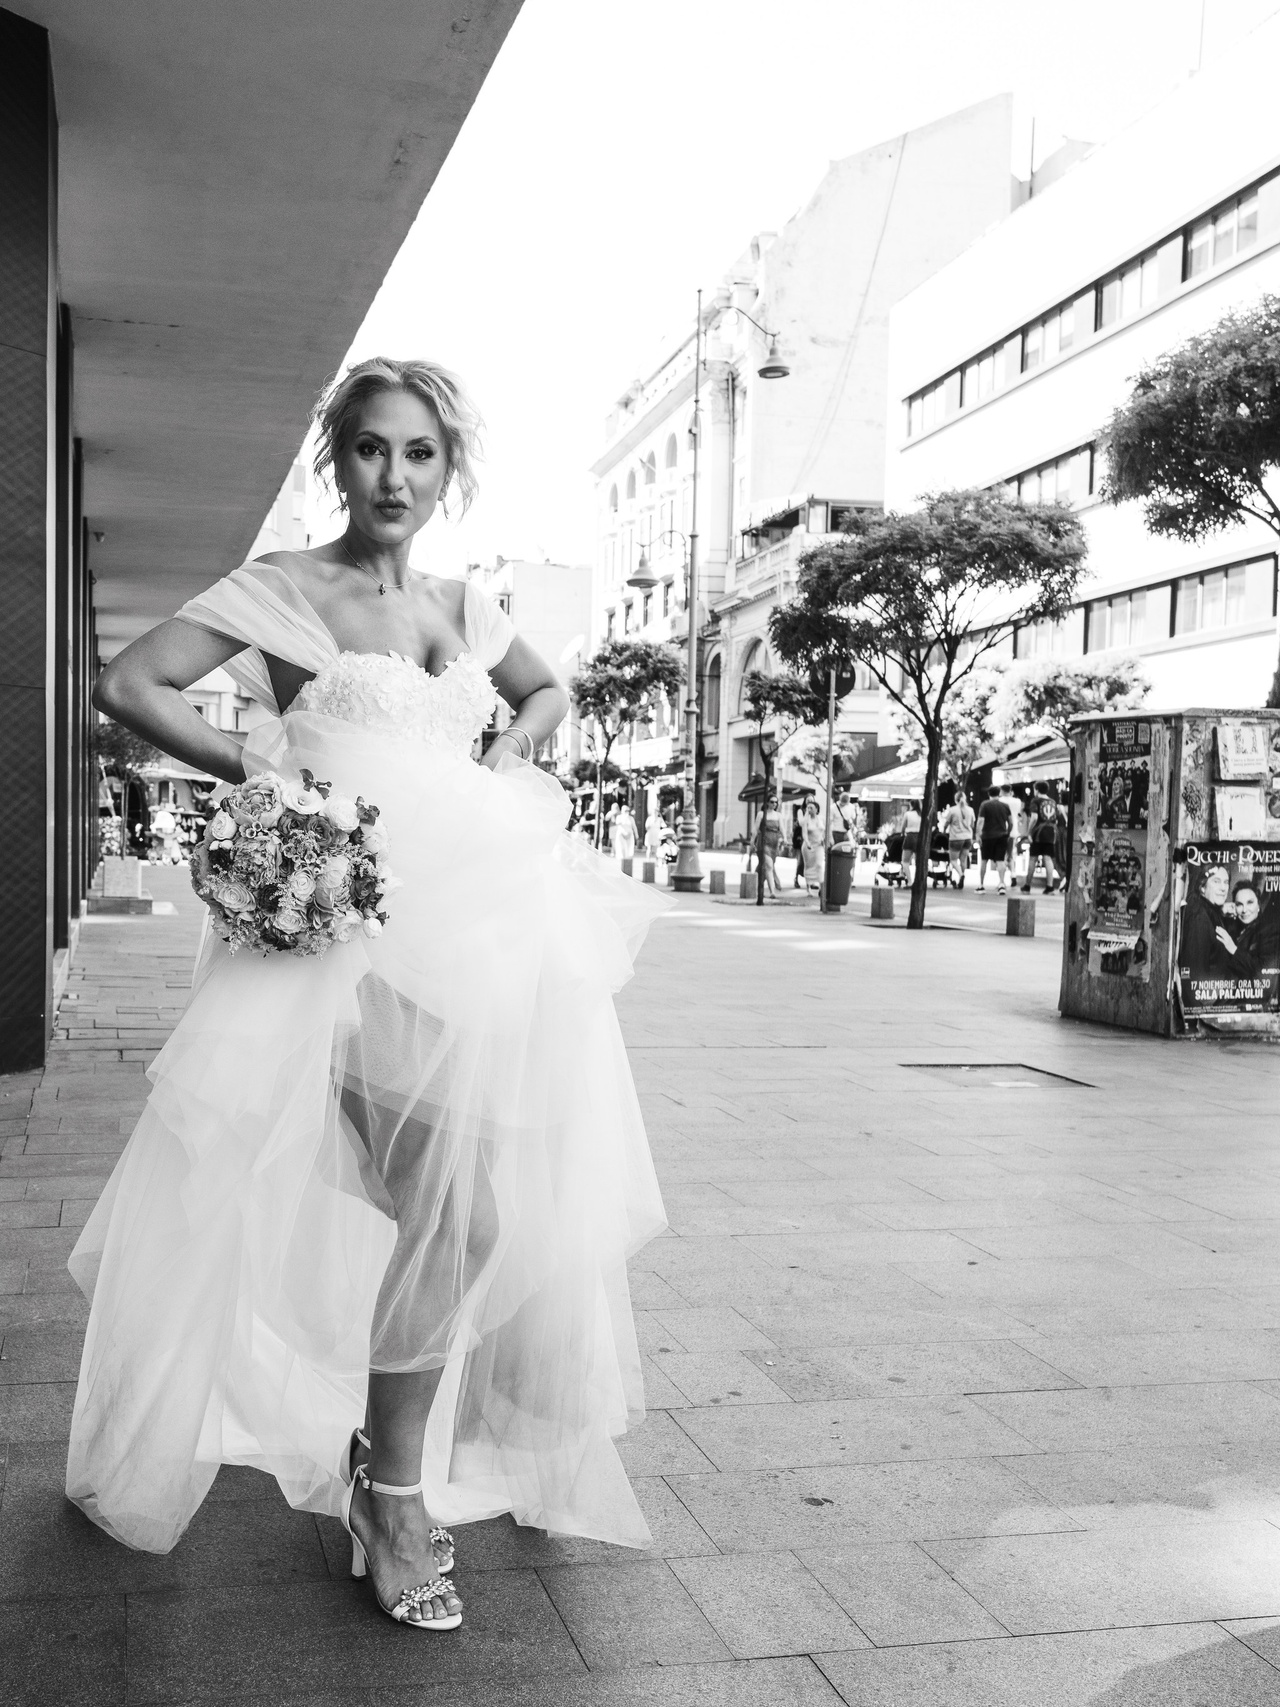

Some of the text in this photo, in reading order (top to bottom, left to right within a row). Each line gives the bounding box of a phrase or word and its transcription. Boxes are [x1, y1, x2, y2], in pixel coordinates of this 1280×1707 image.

[1238, 845, 1280, 864] POVER
[1191, 981, 1197, 990] 17
[1238, 979, 1252, 989] ORA
[1195, 988, 1263, 1000] SALA PALATULUI
